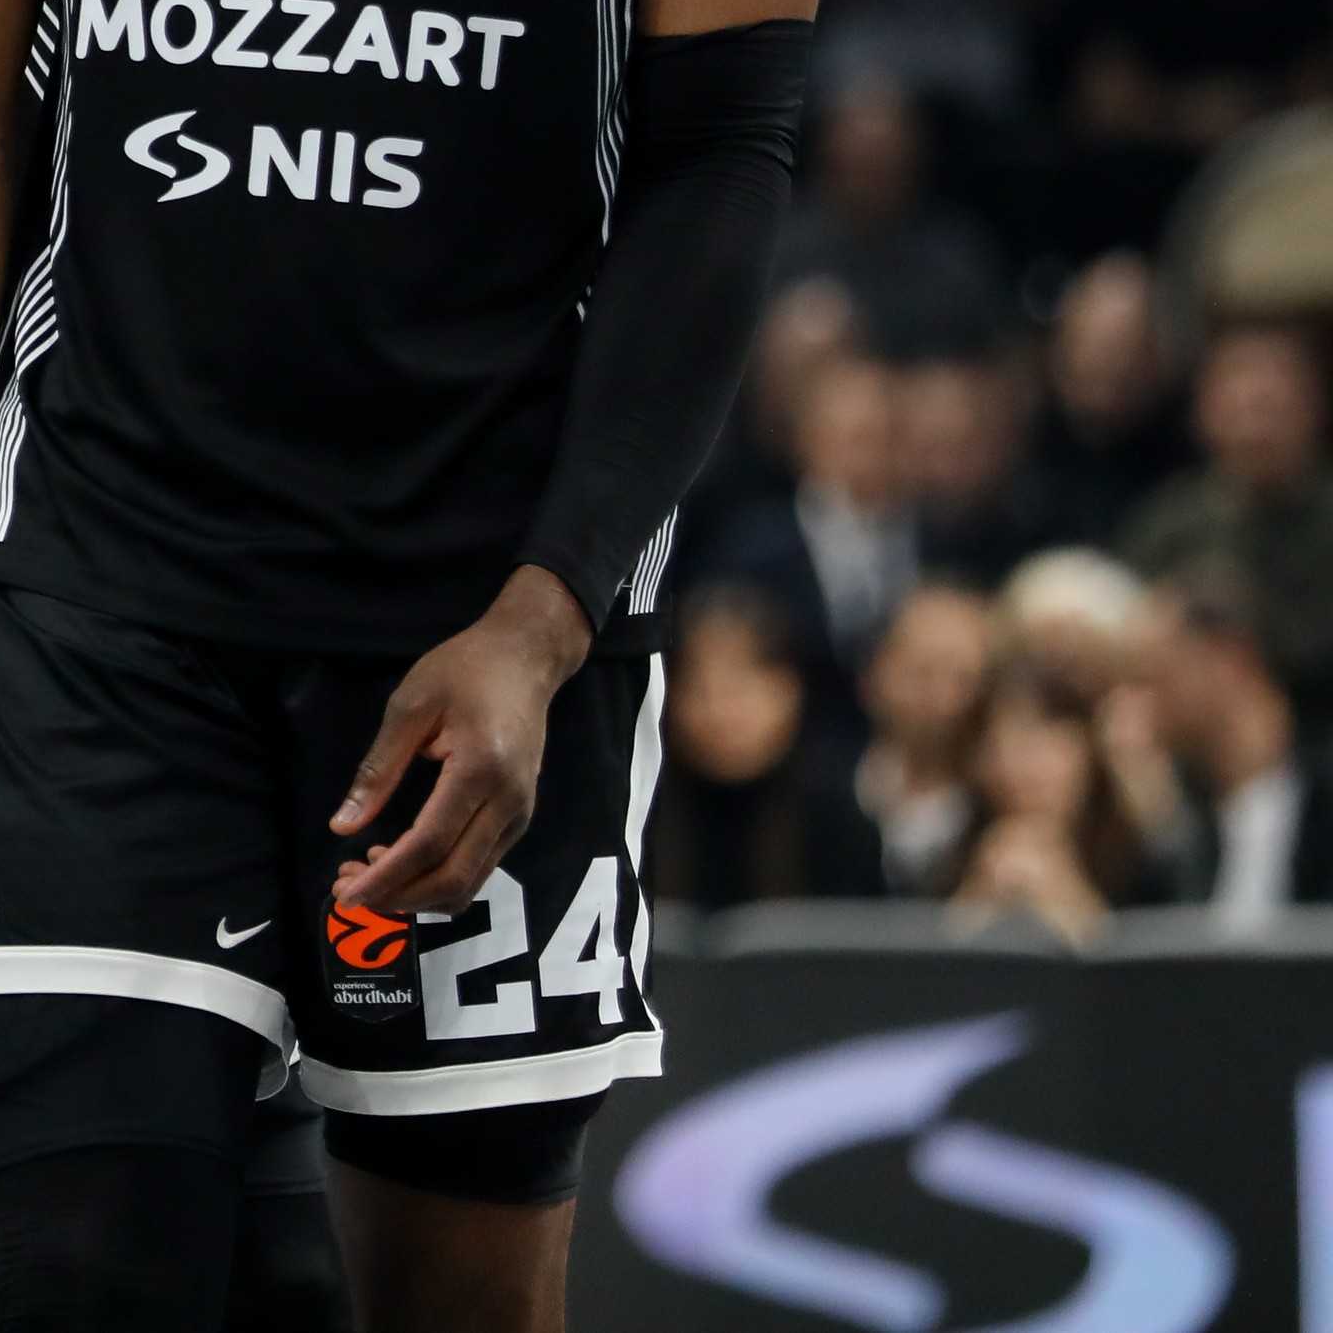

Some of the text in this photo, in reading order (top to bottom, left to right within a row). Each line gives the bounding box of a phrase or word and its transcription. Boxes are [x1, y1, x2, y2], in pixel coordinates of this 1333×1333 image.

[247, 125, 425, 209] NIS
[416, 855, 625, 1041] 24
[333, 982, 375, 990] experience
[333, 989, 413, 1004] abu dhabi
